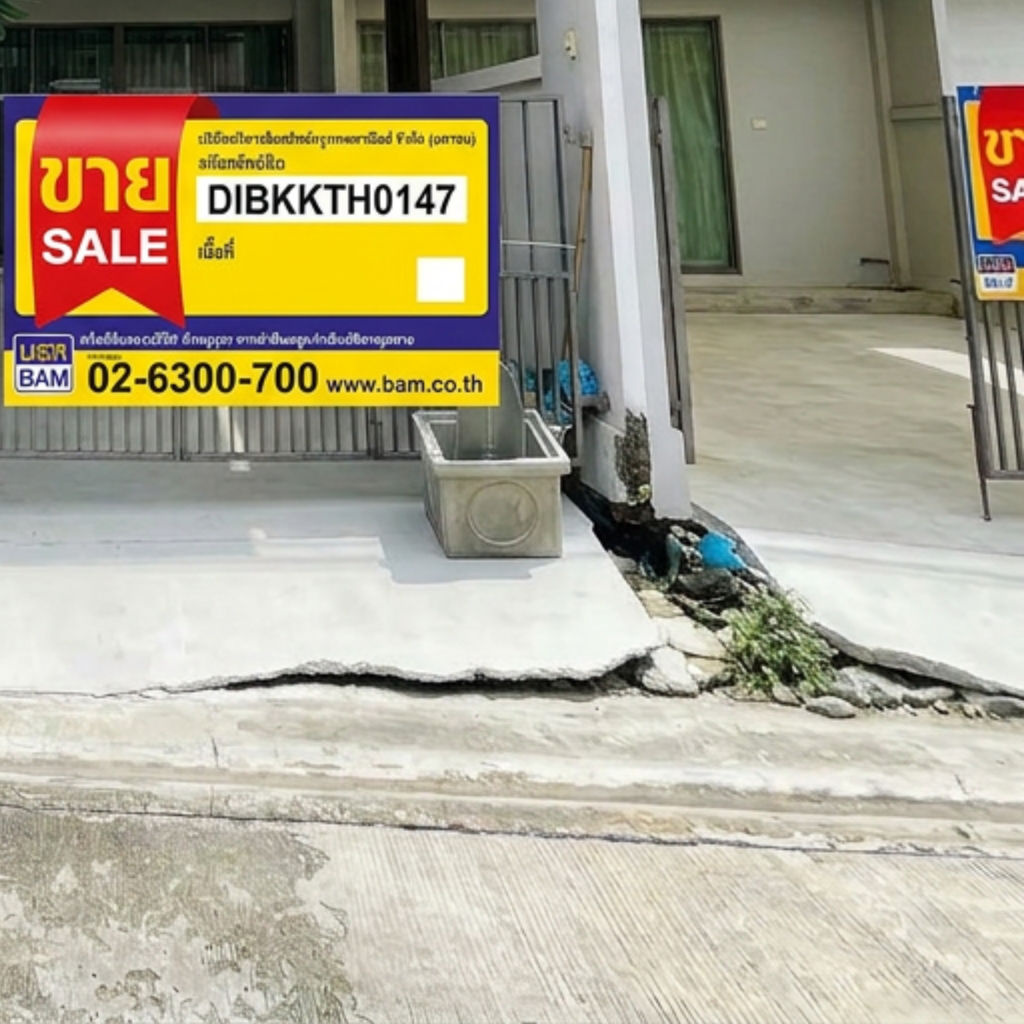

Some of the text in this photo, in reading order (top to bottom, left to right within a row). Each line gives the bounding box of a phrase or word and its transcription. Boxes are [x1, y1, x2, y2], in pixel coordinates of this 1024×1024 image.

[41, 157, 169, 212] ขาย
[209, 184, 455, 214] DIBKKTH0147
[43, 228, 167, 264] SALE
[20, 370, 68, 386] BAM
[88, 362, 482, 393] 02-6300-700 www.bam.co.th
